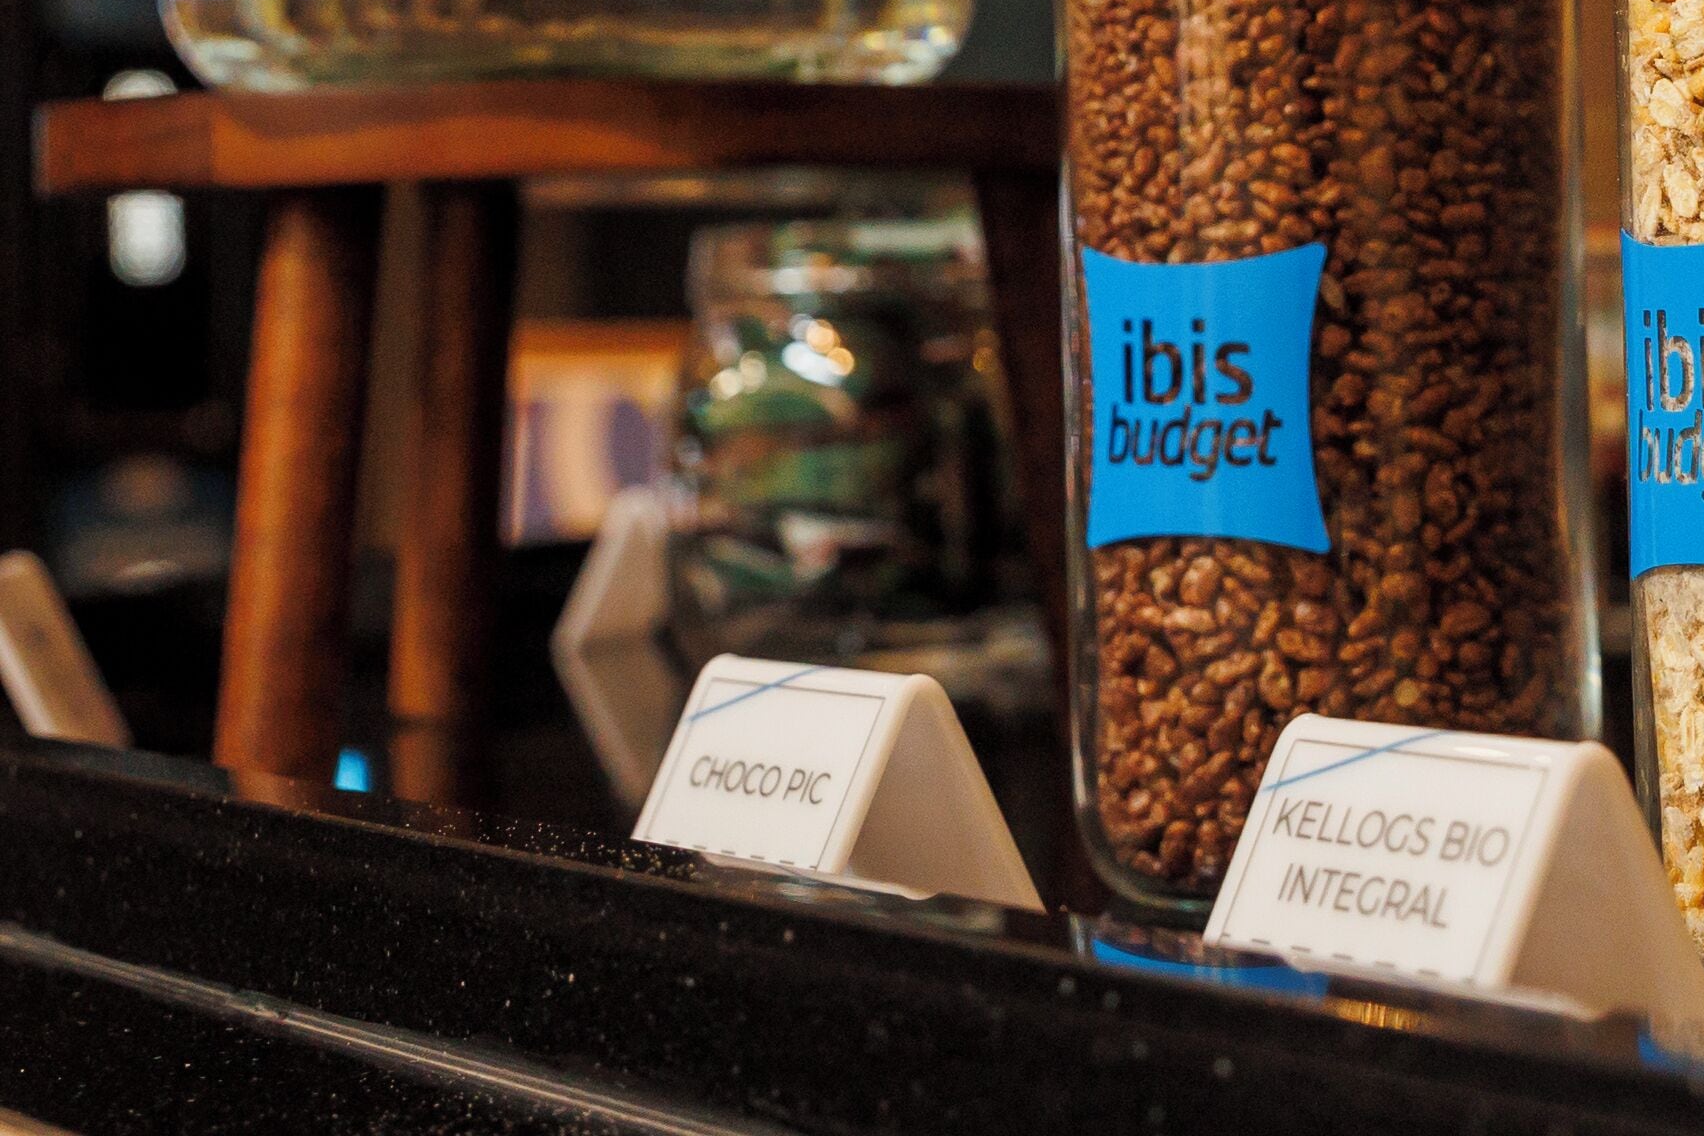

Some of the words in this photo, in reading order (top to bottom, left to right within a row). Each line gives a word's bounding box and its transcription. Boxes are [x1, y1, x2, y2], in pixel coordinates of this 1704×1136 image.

[1122, 318, 1254, 406] ibis
[1108, 402, 1282, 483] budget
[689, 754, 783, 798] CHOCO
[783, 767, 832, 806] PIC
[1271, 796, 1430, 857] KELLOGS
[1439, 820, 1511, 866] BIO
[1277, 863, 1451, 930] INTEGRAL
